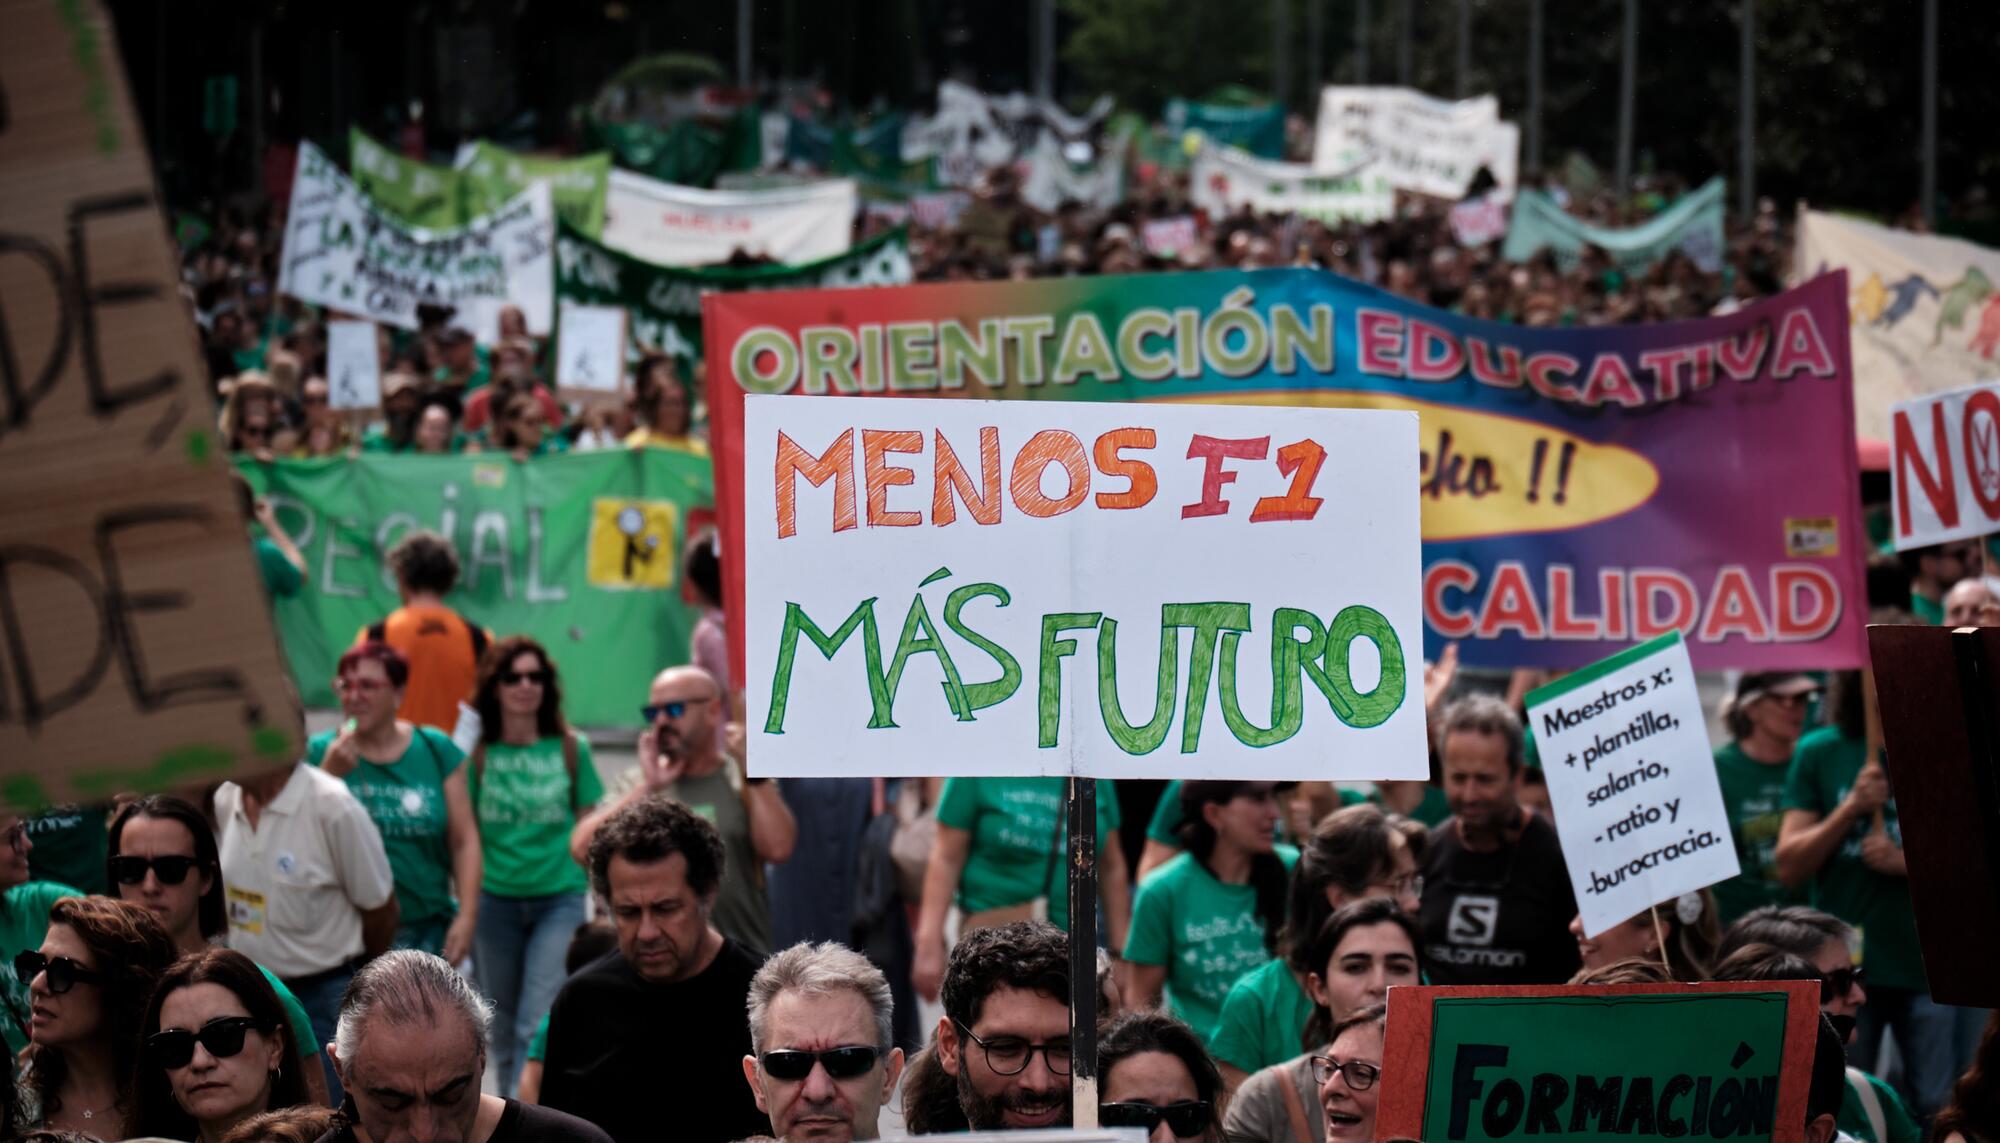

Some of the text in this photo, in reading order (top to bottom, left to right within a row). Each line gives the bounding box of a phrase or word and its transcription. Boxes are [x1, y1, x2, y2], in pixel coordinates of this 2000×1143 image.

[731, 287, 1334, 396] ORIENTACIÓN
[1357, 307, 1836, 407] EDUCATIVA
[775, 426, 1328, 539] MENOS F1
[1893, 389, 2000, 537] NO
[1422, 560, 1842, 641] CALIDAD
[763, 566, 1406, 756] MÁS FUTURO
[1543, 667, 1674, 738] Maestros x:
[1582, 710, 1680, 772] plantilla,
[1586, 759, 1670, 807] salario,
[1607, 804, 1661, 843] ratio
[1665, 798, 1681, 823] y
[1585, 829, 1722, 896] -burocracia.
[1447, 1041, 1780, 1142] FORMACIÓN
